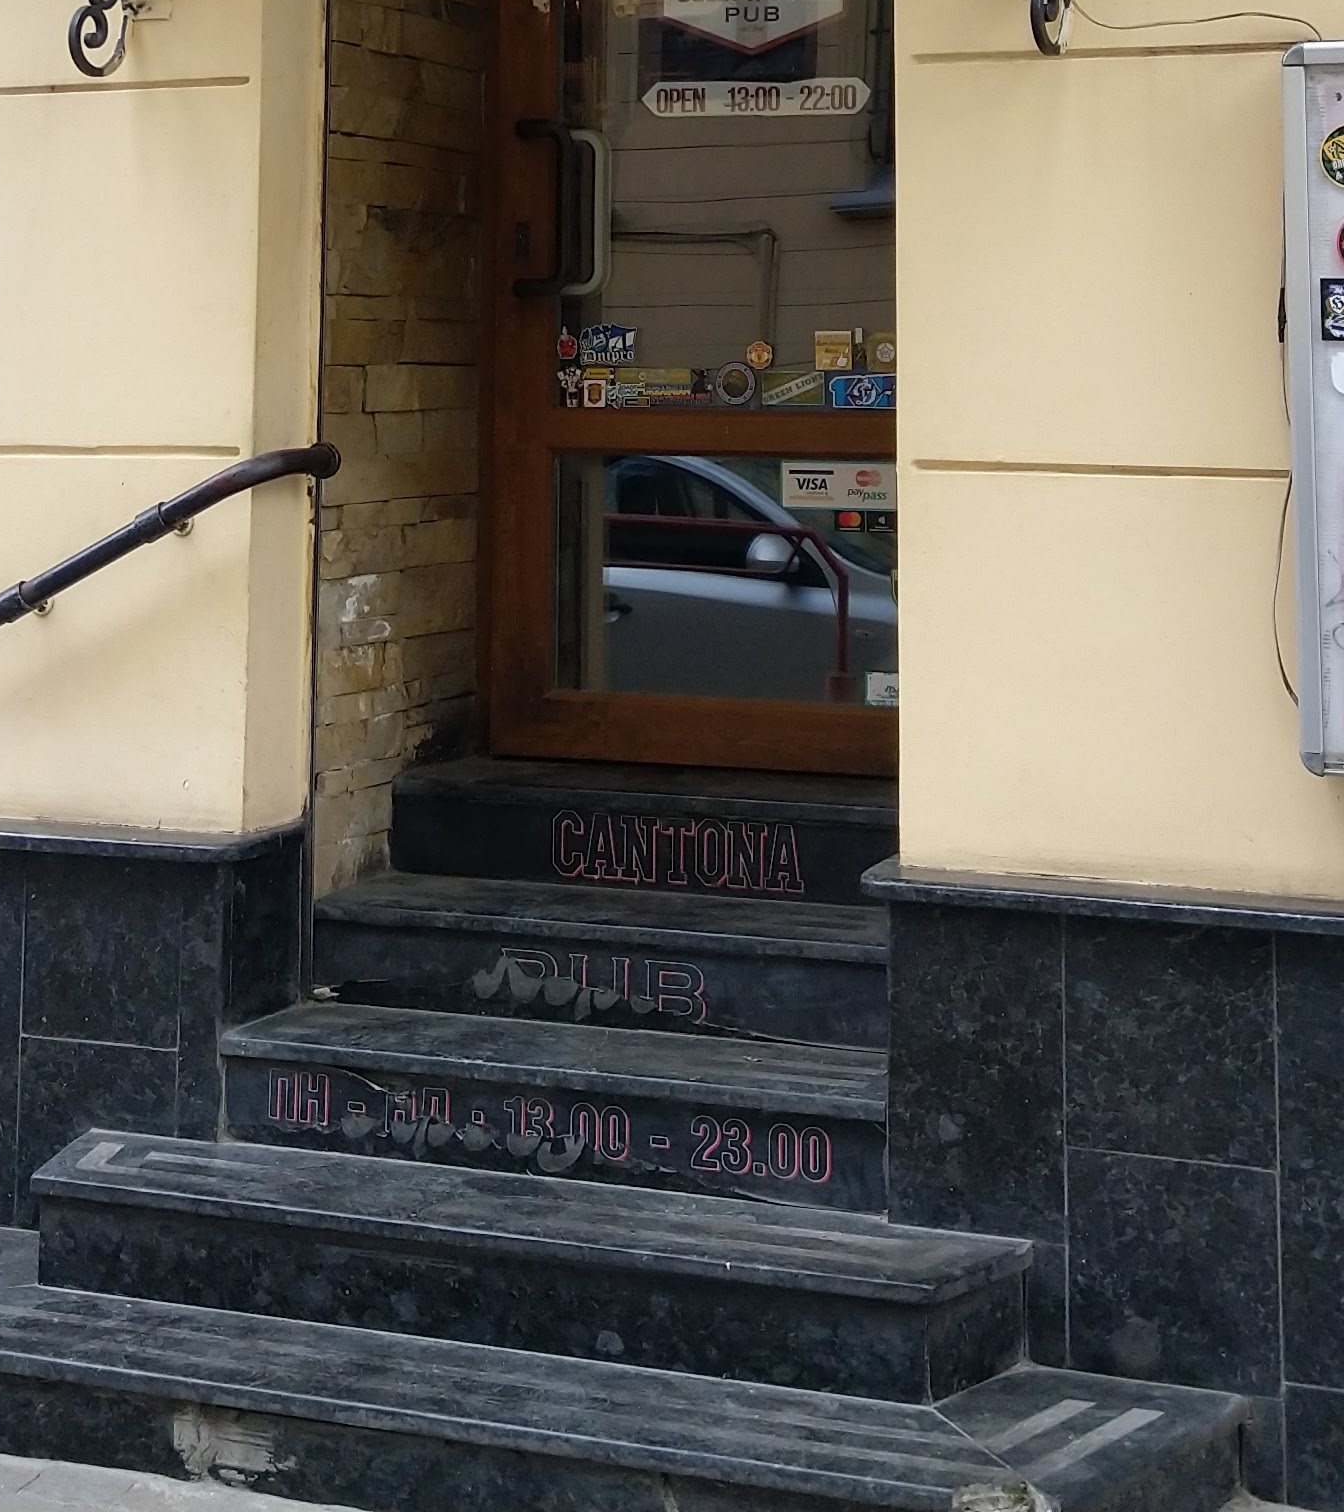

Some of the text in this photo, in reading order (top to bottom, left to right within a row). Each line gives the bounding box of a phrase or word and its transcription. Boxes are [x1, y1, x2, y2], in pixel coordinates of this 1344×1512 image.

[725, 6, 780, 23] PUB
[656, 87, 706, 114] OPEN
[726, 85, 781, 113] 13:00
[799, 84, 857, 111] 22:00
[581, 348, 635, 364] Dnipro
[794, 478, 829, 491] VISA
[551, 809, 805, 894] CANTONA
[267, 1067, 330, 1128] ПН
[690, 1114, 832, 1185] 23.00
